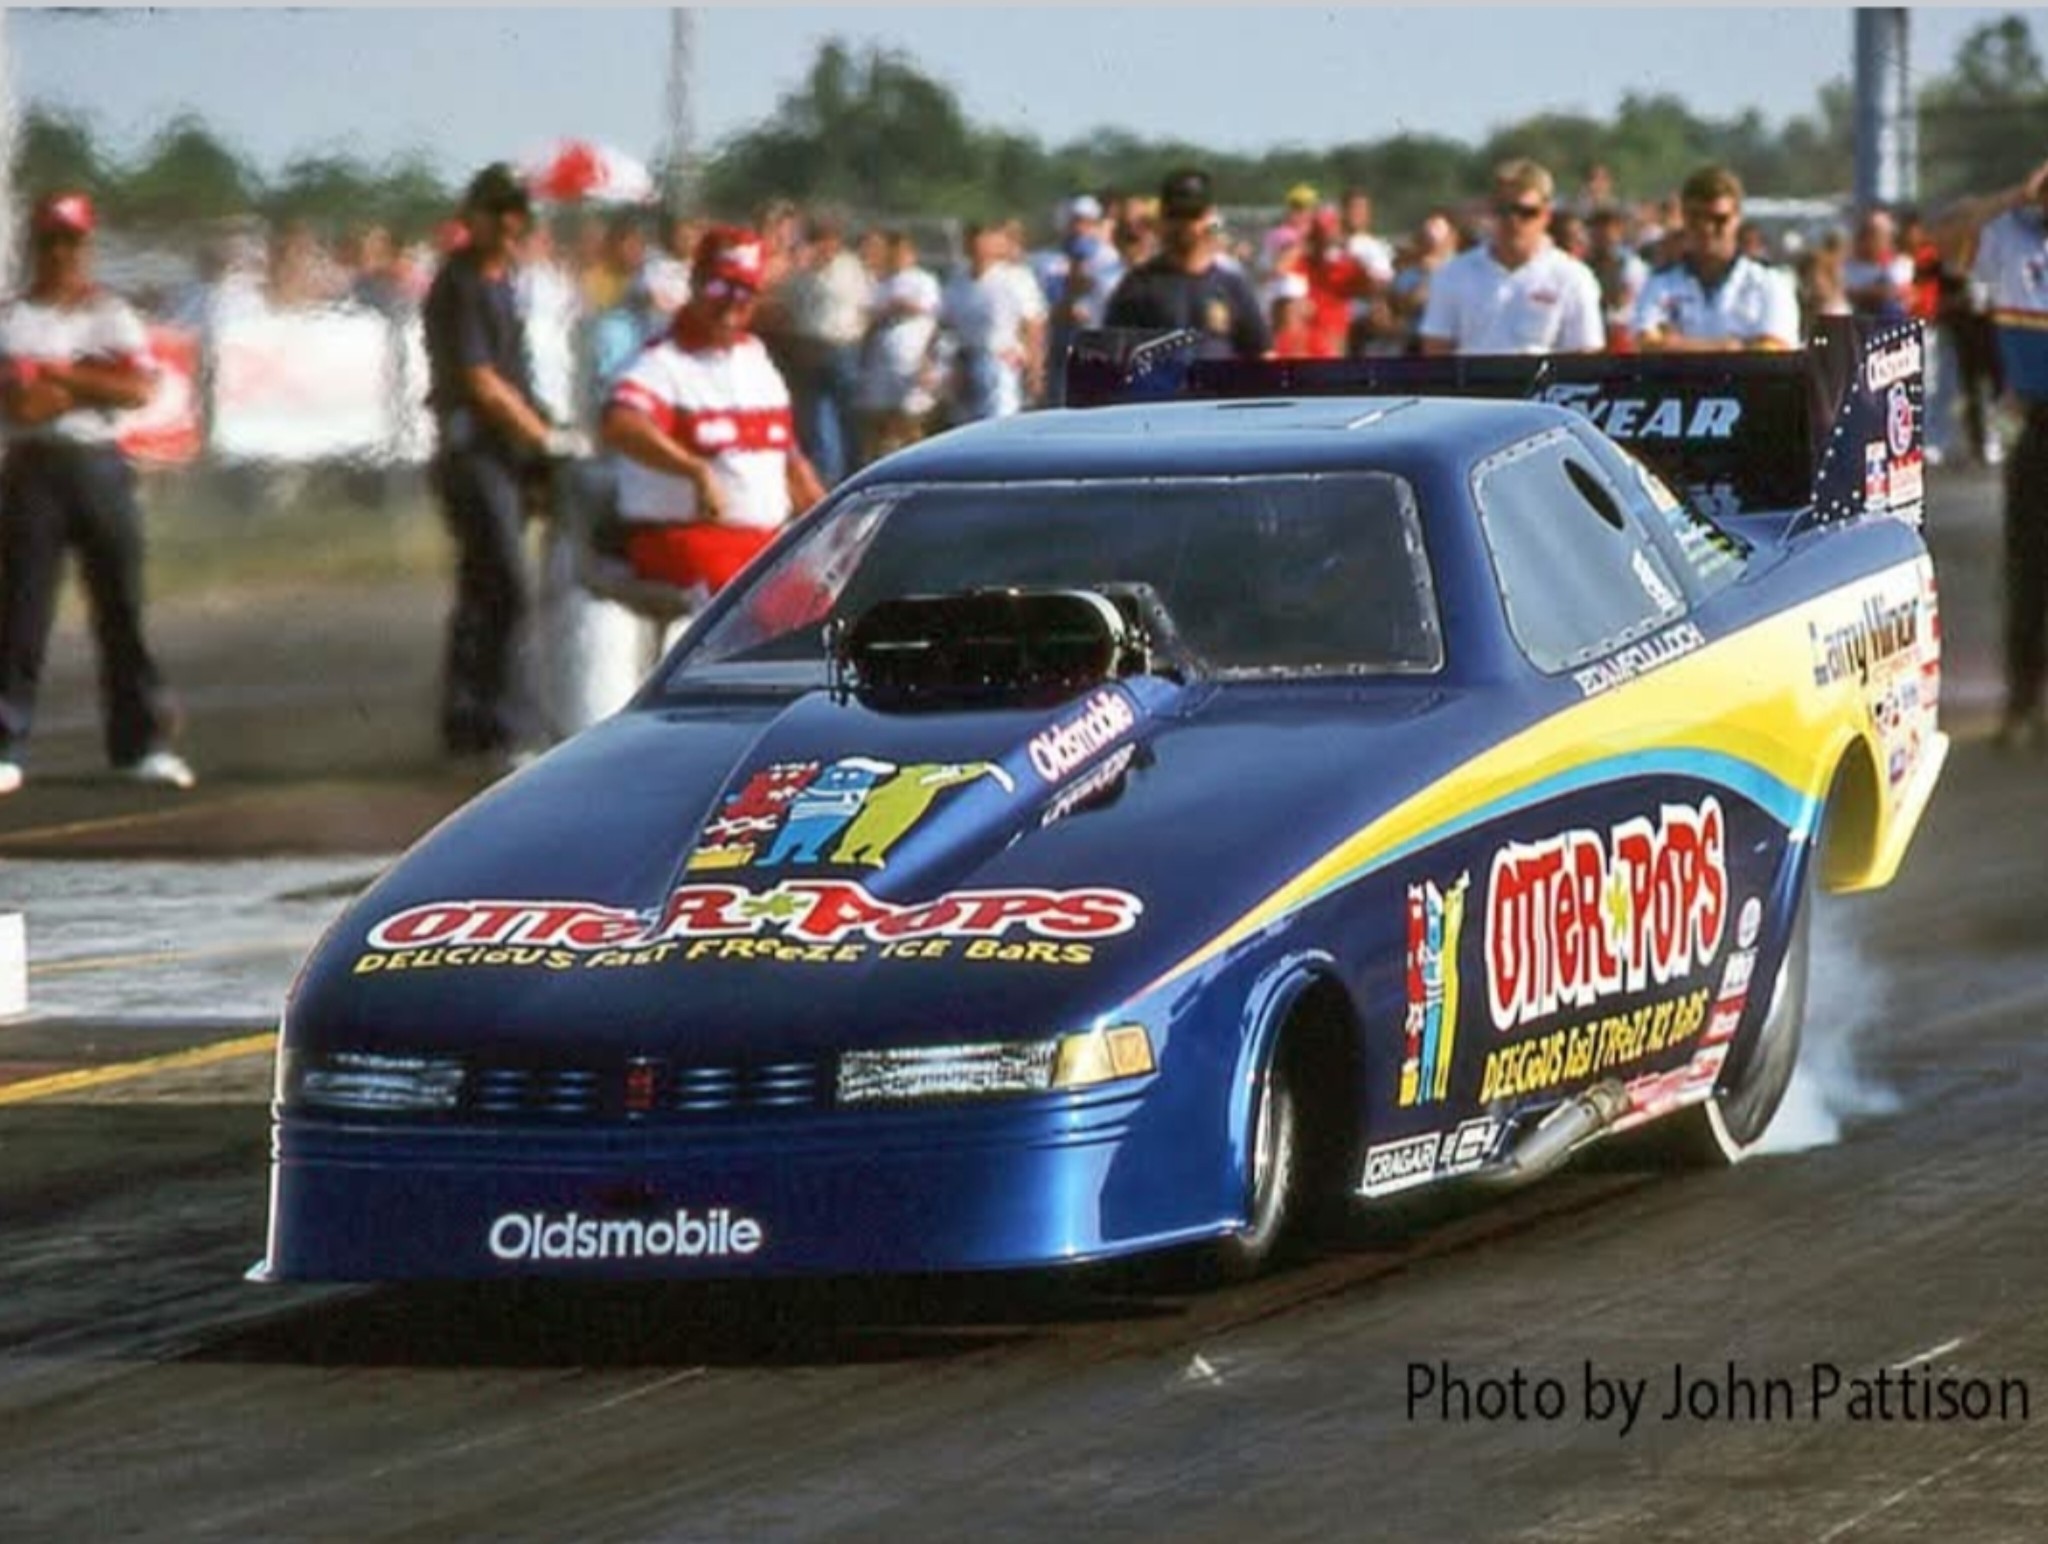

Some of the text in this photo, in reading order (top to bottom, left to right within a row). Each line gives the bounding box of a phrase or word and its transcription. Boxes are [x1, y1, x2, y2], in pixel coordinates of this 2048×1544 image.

[879, 939, 952, 959] ICE
[1367, 1139, 1435, 1184] CRAGAR
[489, 1208, 762, 1259] Oldsmobile
